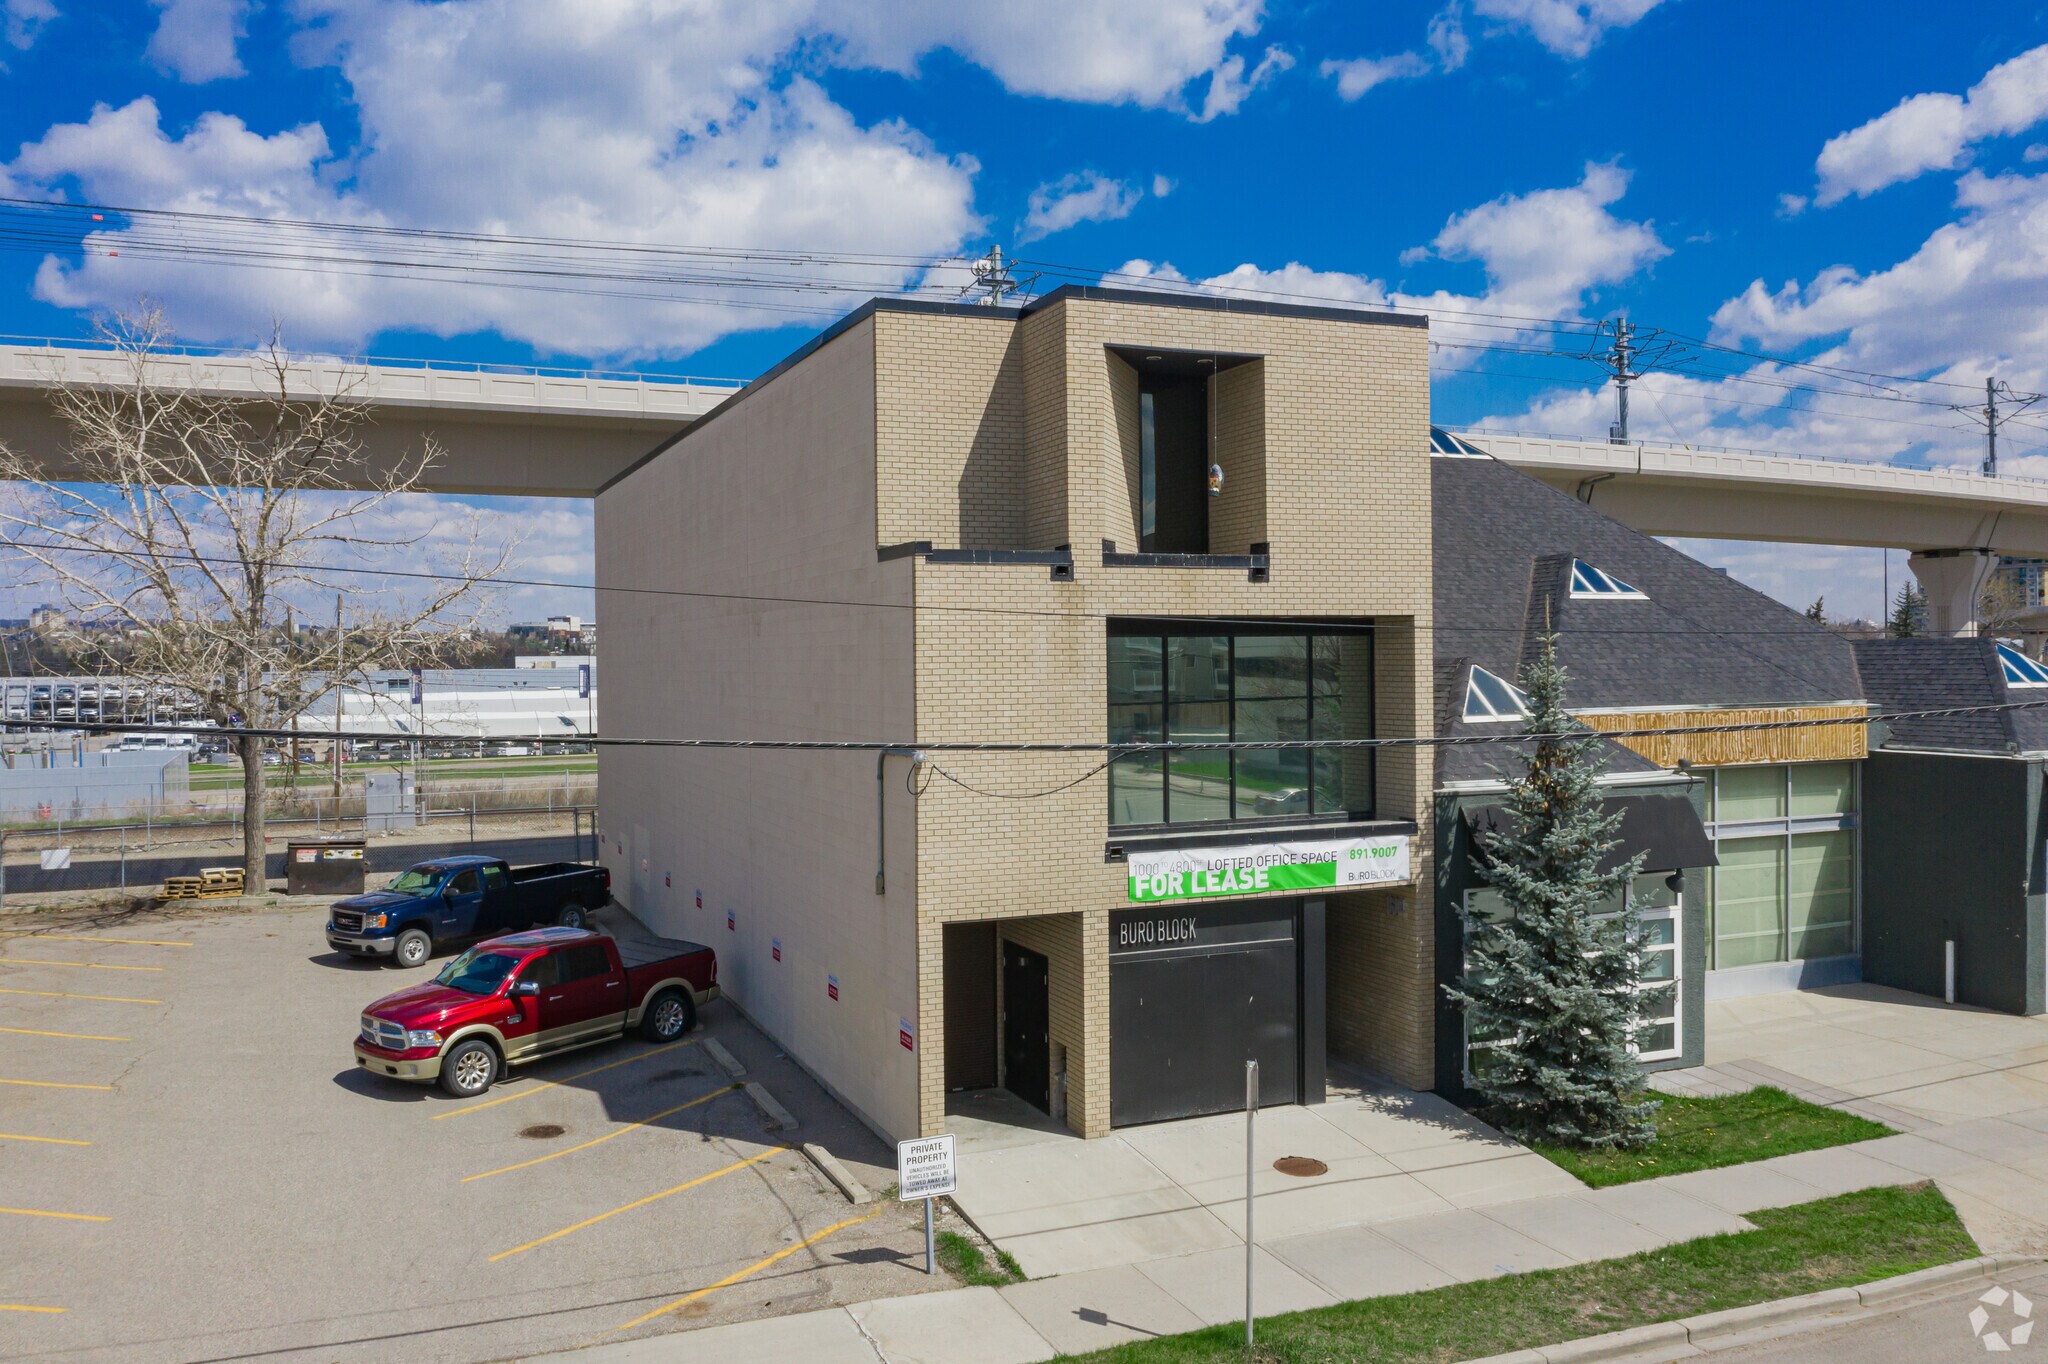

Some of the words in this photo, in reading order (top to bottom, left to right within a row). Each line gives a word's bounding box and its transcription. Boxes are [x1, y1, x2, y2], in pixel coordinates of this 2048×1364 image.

[1350, 846, 1397, 860] 891.9007
[1134, 863, 1159, 877] 1000
[1169, 860, 1196, 874] 4800
[1207, 857, 1253, 871] LOFTED
[1256, 854, 1298, 868] OFFICE
[1301, 851, 1337, 865] SPACE
[1135, 872, 1185, 899] FOR
[1191, 866, 1270, 894] LEASE
[1120, 920, 1154, 945] BURO
[1157, 917, 1197, 942] BLOCK
[910, 1142, 943, 1154] PRIVATE
[906, 1152, 948, 1165] PROPERTY
[909, 1163, 946, 1173] UNAUTHORIZED
[906, 1185, 929, 1193] OWNER'S
[930, 1182, 950, 1190] EXPENSE
